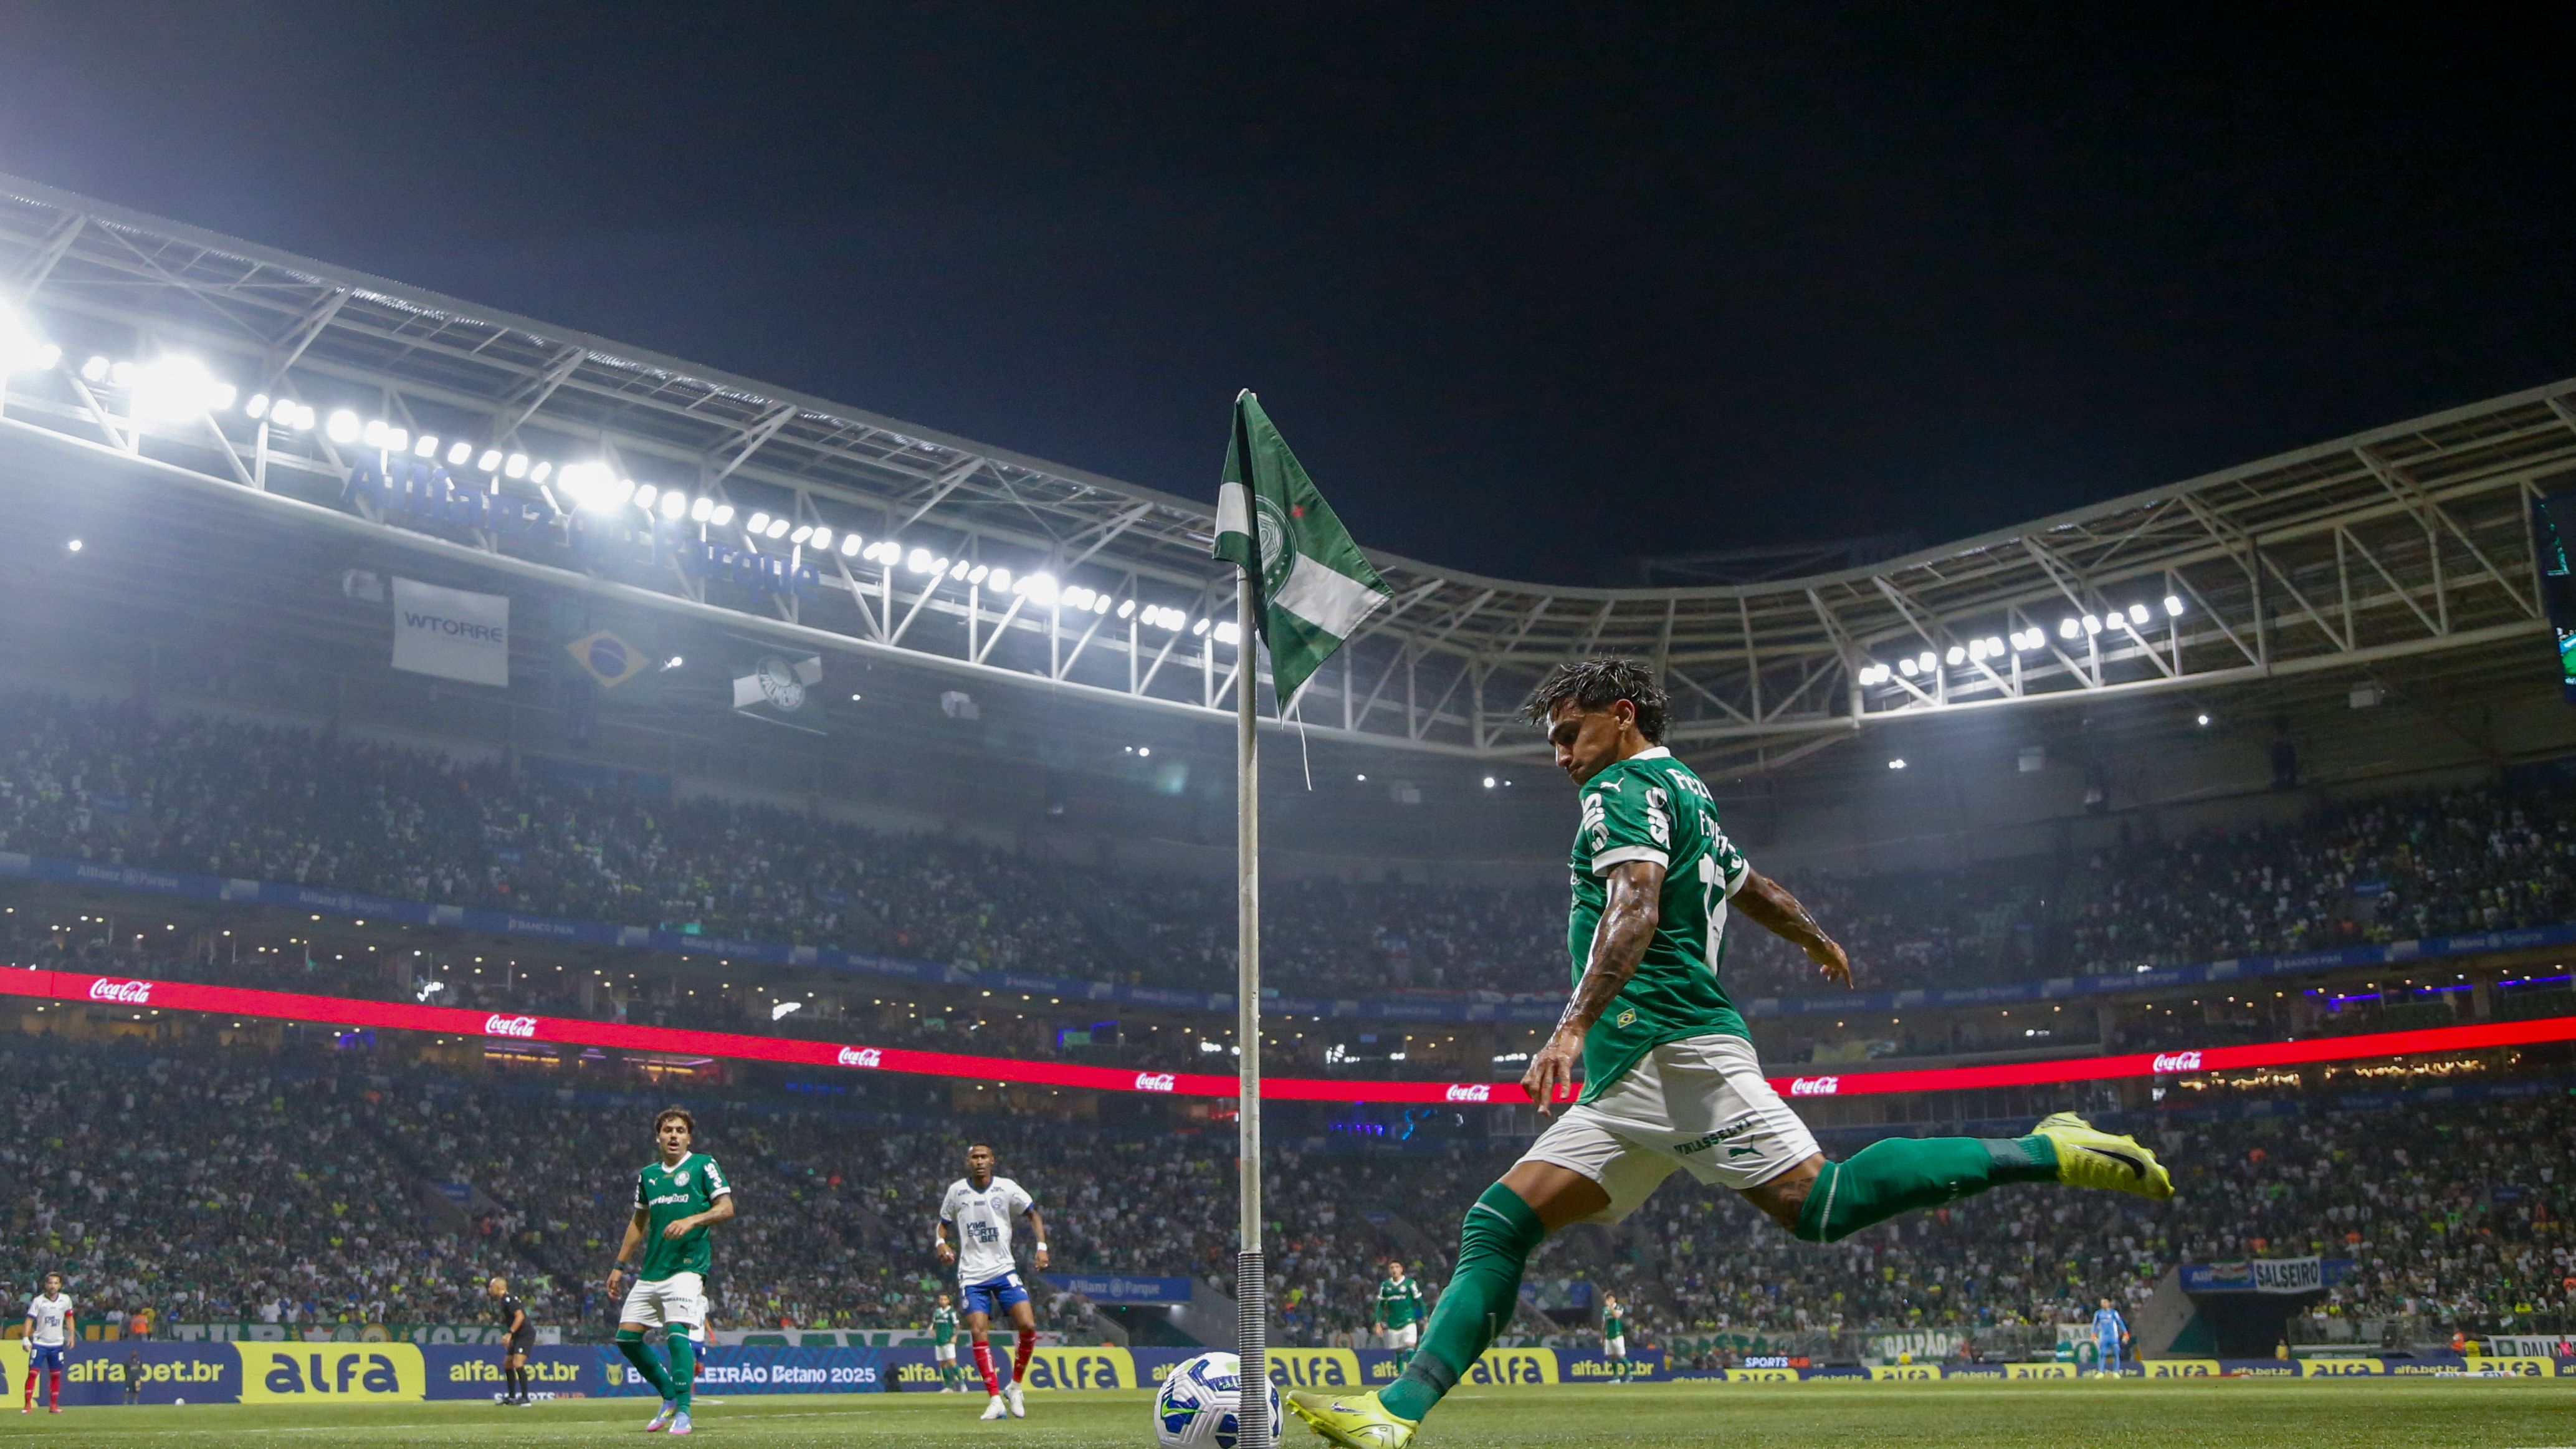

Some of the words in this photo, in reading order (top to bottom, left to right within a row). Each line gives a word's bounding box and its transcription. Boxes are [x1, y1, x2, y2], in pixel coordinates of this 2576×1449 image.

[404, 611, 503, 643] WTORRE
[966, 1222, 986, 1230] VIVA
[968, 1227, 999, 1237] SORTE
[2256, 1260, 2319, 1288] SALSEIRO
[67, 1359, 224, 1382] alfaet.br
[264, 1353, 399, 1394] alfa
[449, 1360, 580, 1382] alfa.et.br
[627, 1363, 768, 1384] BEIRÃO
[772, 1365, 827, 1383] Betano
[831, 1367, 876, 1382] 2025
[1030, 1356, 1120, 1389] alfa
[1269, 1356, 1347, 1387] alfa
[1472, 1356, 1543, 1385] alfa
